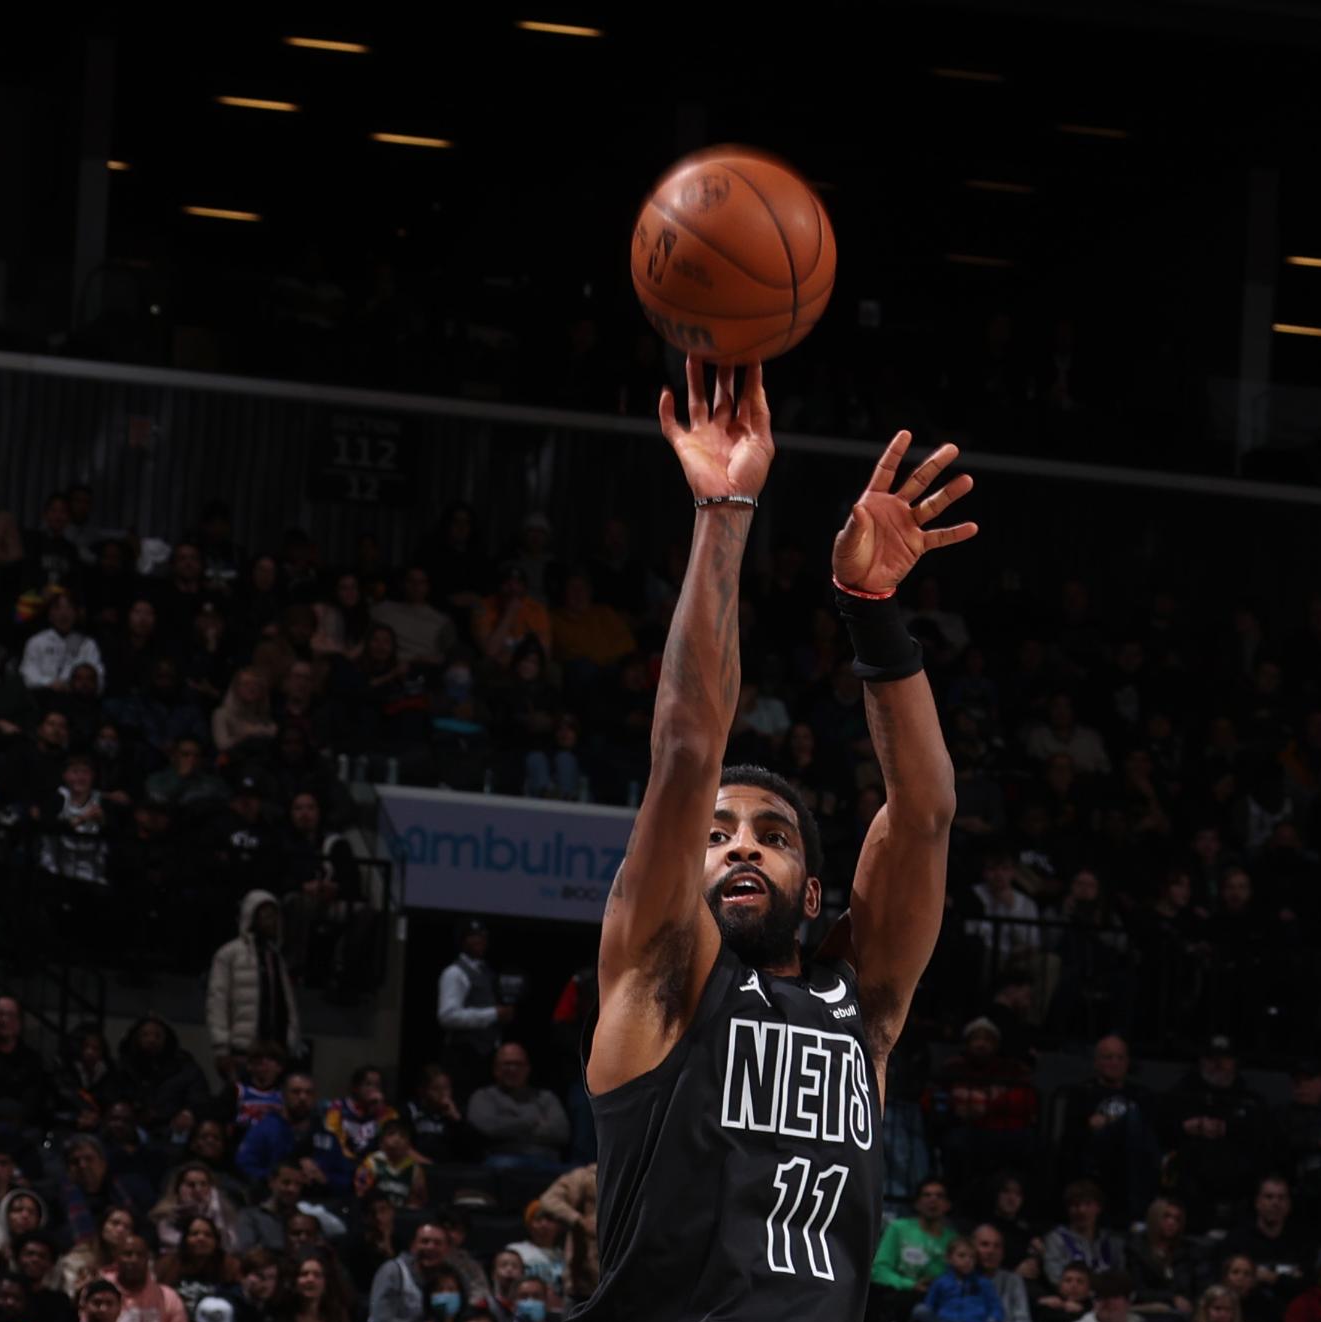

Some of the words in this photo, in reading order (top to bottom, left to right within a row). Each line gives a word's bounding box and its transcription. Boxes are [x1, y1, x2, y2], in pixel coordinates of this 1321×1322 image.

[333, 435, 399, 471] 112
[829, 1003, 858, 1021] ebull
[721, 1017, 873, 1151] NETS
[766, 1155, 850, 1282] 11
